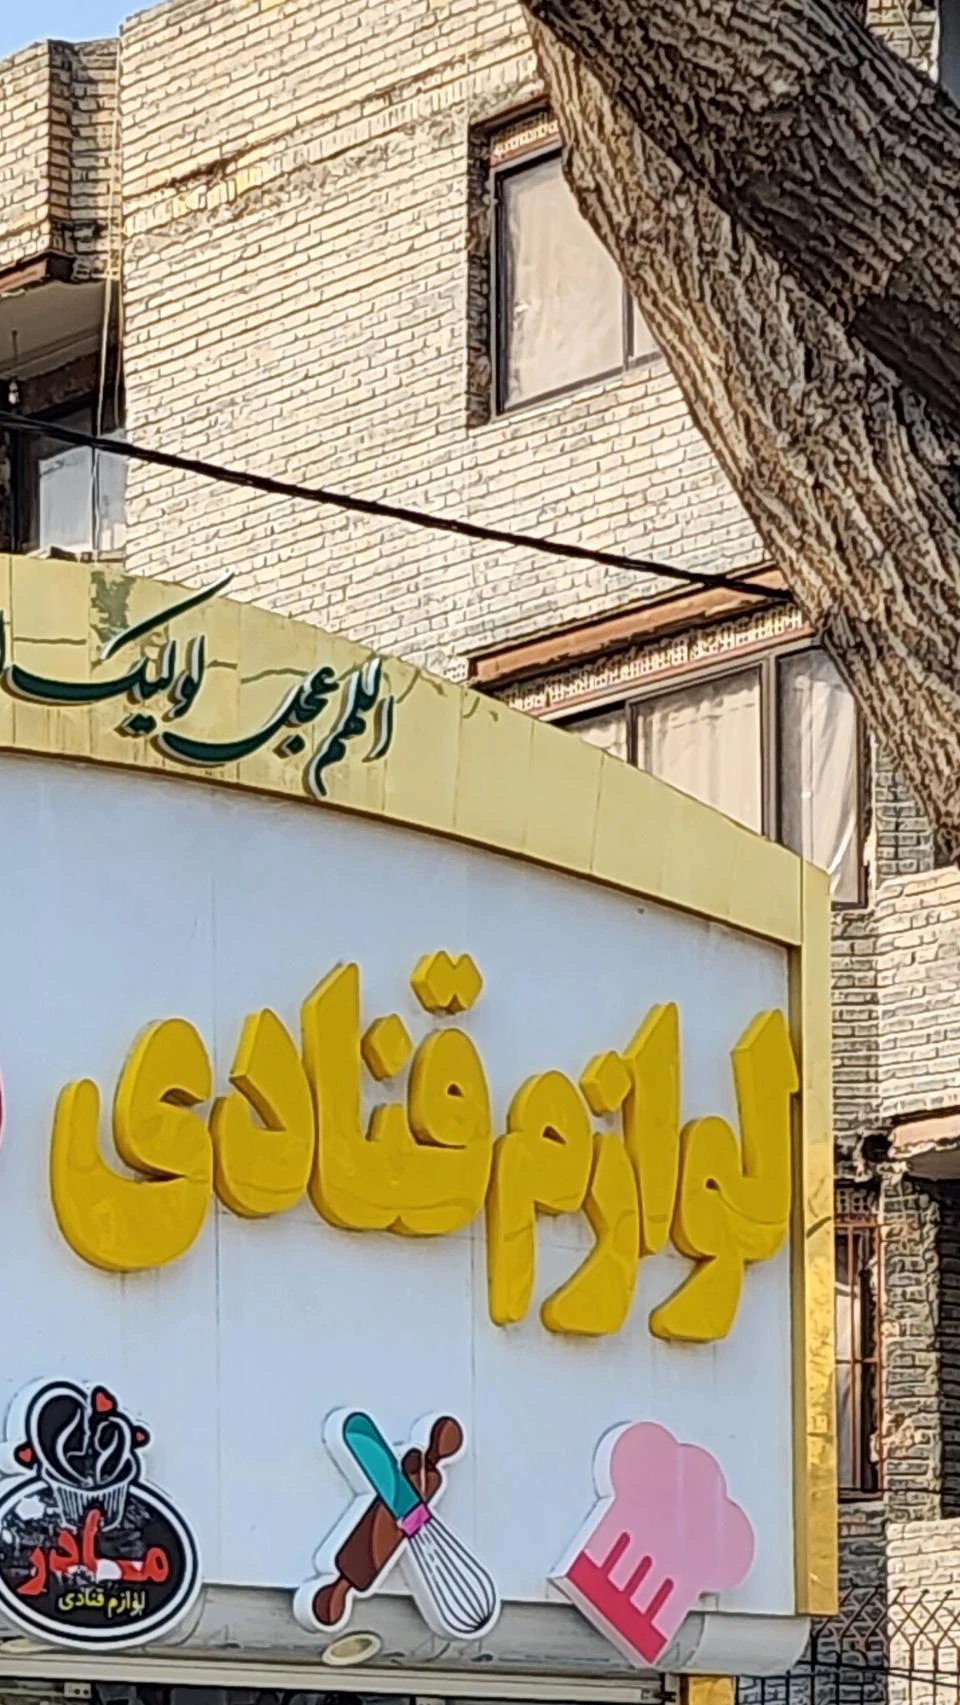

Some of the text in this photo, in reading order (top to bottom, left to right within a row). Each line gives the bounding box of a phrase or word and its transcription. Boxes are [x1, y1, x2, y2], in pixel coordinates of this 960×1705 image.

[152, 664, 341, 769] عجل
[302, 653, 394, 800] اللهم
[48, 949, 799, 1343] لوازم قنادی
[16, 1508, 170, 1596] مادر
[57, 1586, 146, 1619] لوازم قنادی
